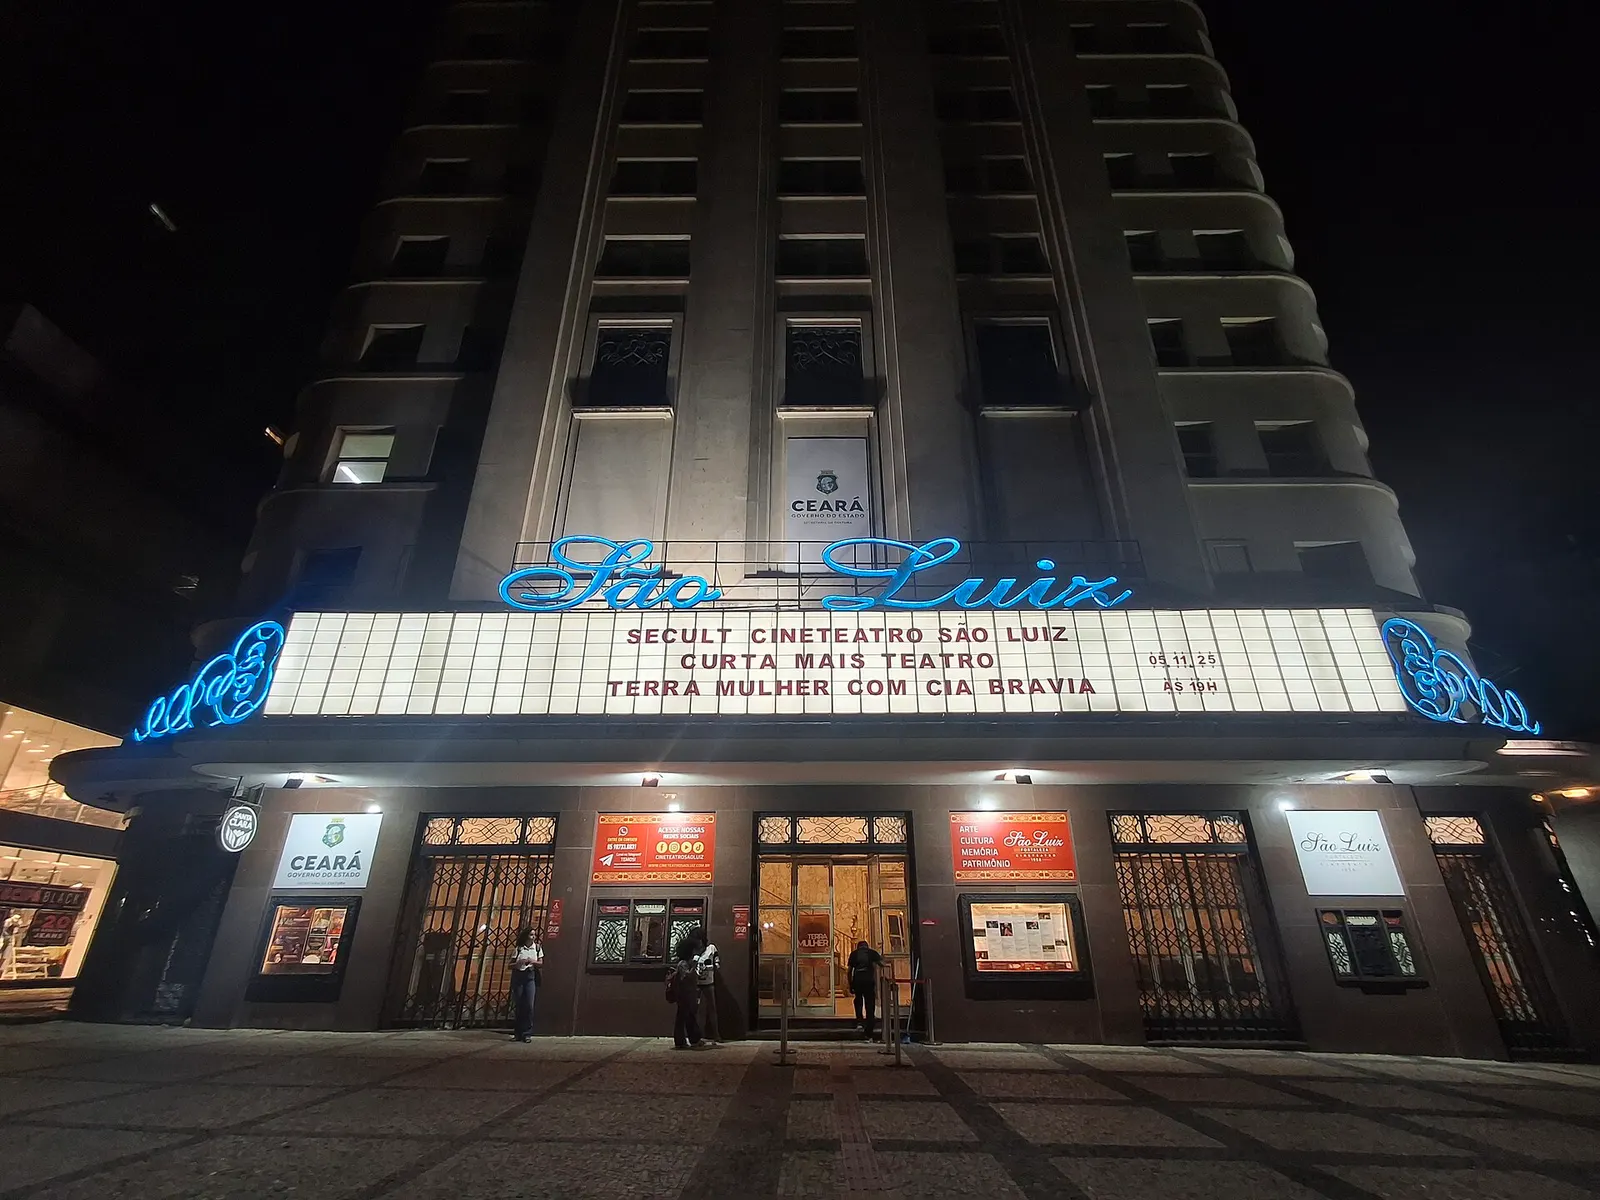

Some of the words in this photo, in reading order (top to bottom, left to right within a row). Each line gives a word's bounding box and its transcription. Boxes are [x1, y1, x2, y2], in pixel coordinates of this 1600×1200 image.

[791, 496, 865, 512] CEARÁ
[498, 535, 722, 611] São
[821, 537, 1133, 611] Luiz
[626, 628, 733, 644] SECULT
[751, 627, 923, 644] CINETEATRO
[938, 621, 989, 643] SÃO
[1007, 626, 1069, 642] LUIZ
[680, 653, 777, 670] CURTA
[795, 653, 866, 669] MAIS
[881, 653, 994, 669] TEATRO
[607, 680, 701, 697] TERRA
[716, 679, 830, 696] MULHER
[848, 679, 907, 696] COM
[926, 679, 972, 696] CIA
[988, 678, 1096, 695] BRAVIA
[1189, 681, 1218, 692] 19H
[229, 818, 253, 830] CLARA
[233, 811, 253, 822] SANTA
[658, 826, 680, 834] ACESSE
[680, 826, 705, 834] NOSSAS
[959, 825, 979, 833] ARTE
[960, 836, 995, 845] CULTURA
[1003, 830, 1031, 847] São
[1033, 830, 1064, 847] Luiz
[1300, 831, 1337, 852] São
[1339, 831, 1381, 852] Luiz
[961, 846, 999, 856] MEMÓRIA
[290, 850, 362, 870] CEARÁ
[962, 857, 1011, 868] PATRIMÔNIO
[42, 890, 80, 905] BLACK
[41, 914, 72, 929] 20
[797, 939, 829, 947] MULHER
